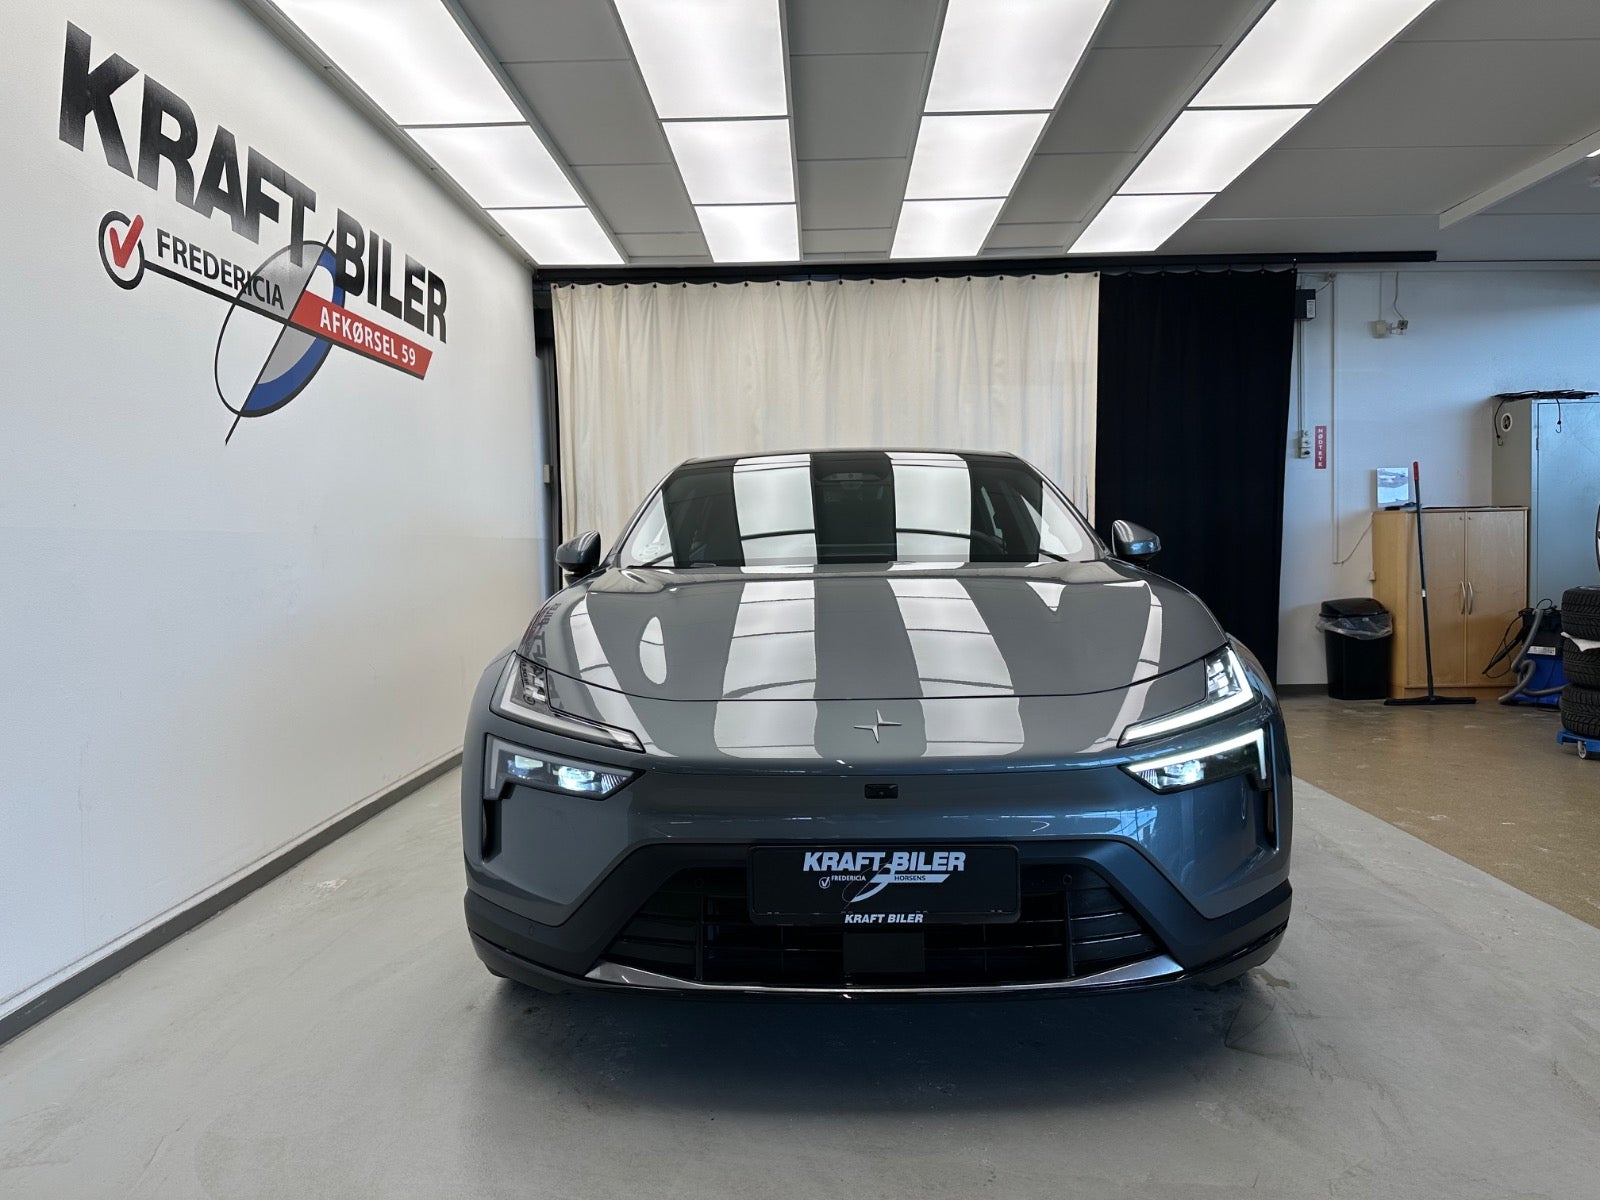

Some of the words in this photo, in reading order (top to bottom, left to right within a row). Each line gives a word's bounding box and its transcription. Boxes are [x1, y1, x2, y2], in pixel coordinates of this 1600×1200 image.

[59, 20, 316, 268] KRAFT
[336, 208, 447, 344] BILER
[156, 228, 285, 311] FREDERICIA
[320, 306, 398, 360] AFKØRSEL
[401, 344, 417, 367] 59
[803, 851, 886, 872] KRAFT
[891, 851, 967, 872] BILER
[844, 913, 885, 924] KRAFT
[887, 913, 924, 924] BILER
